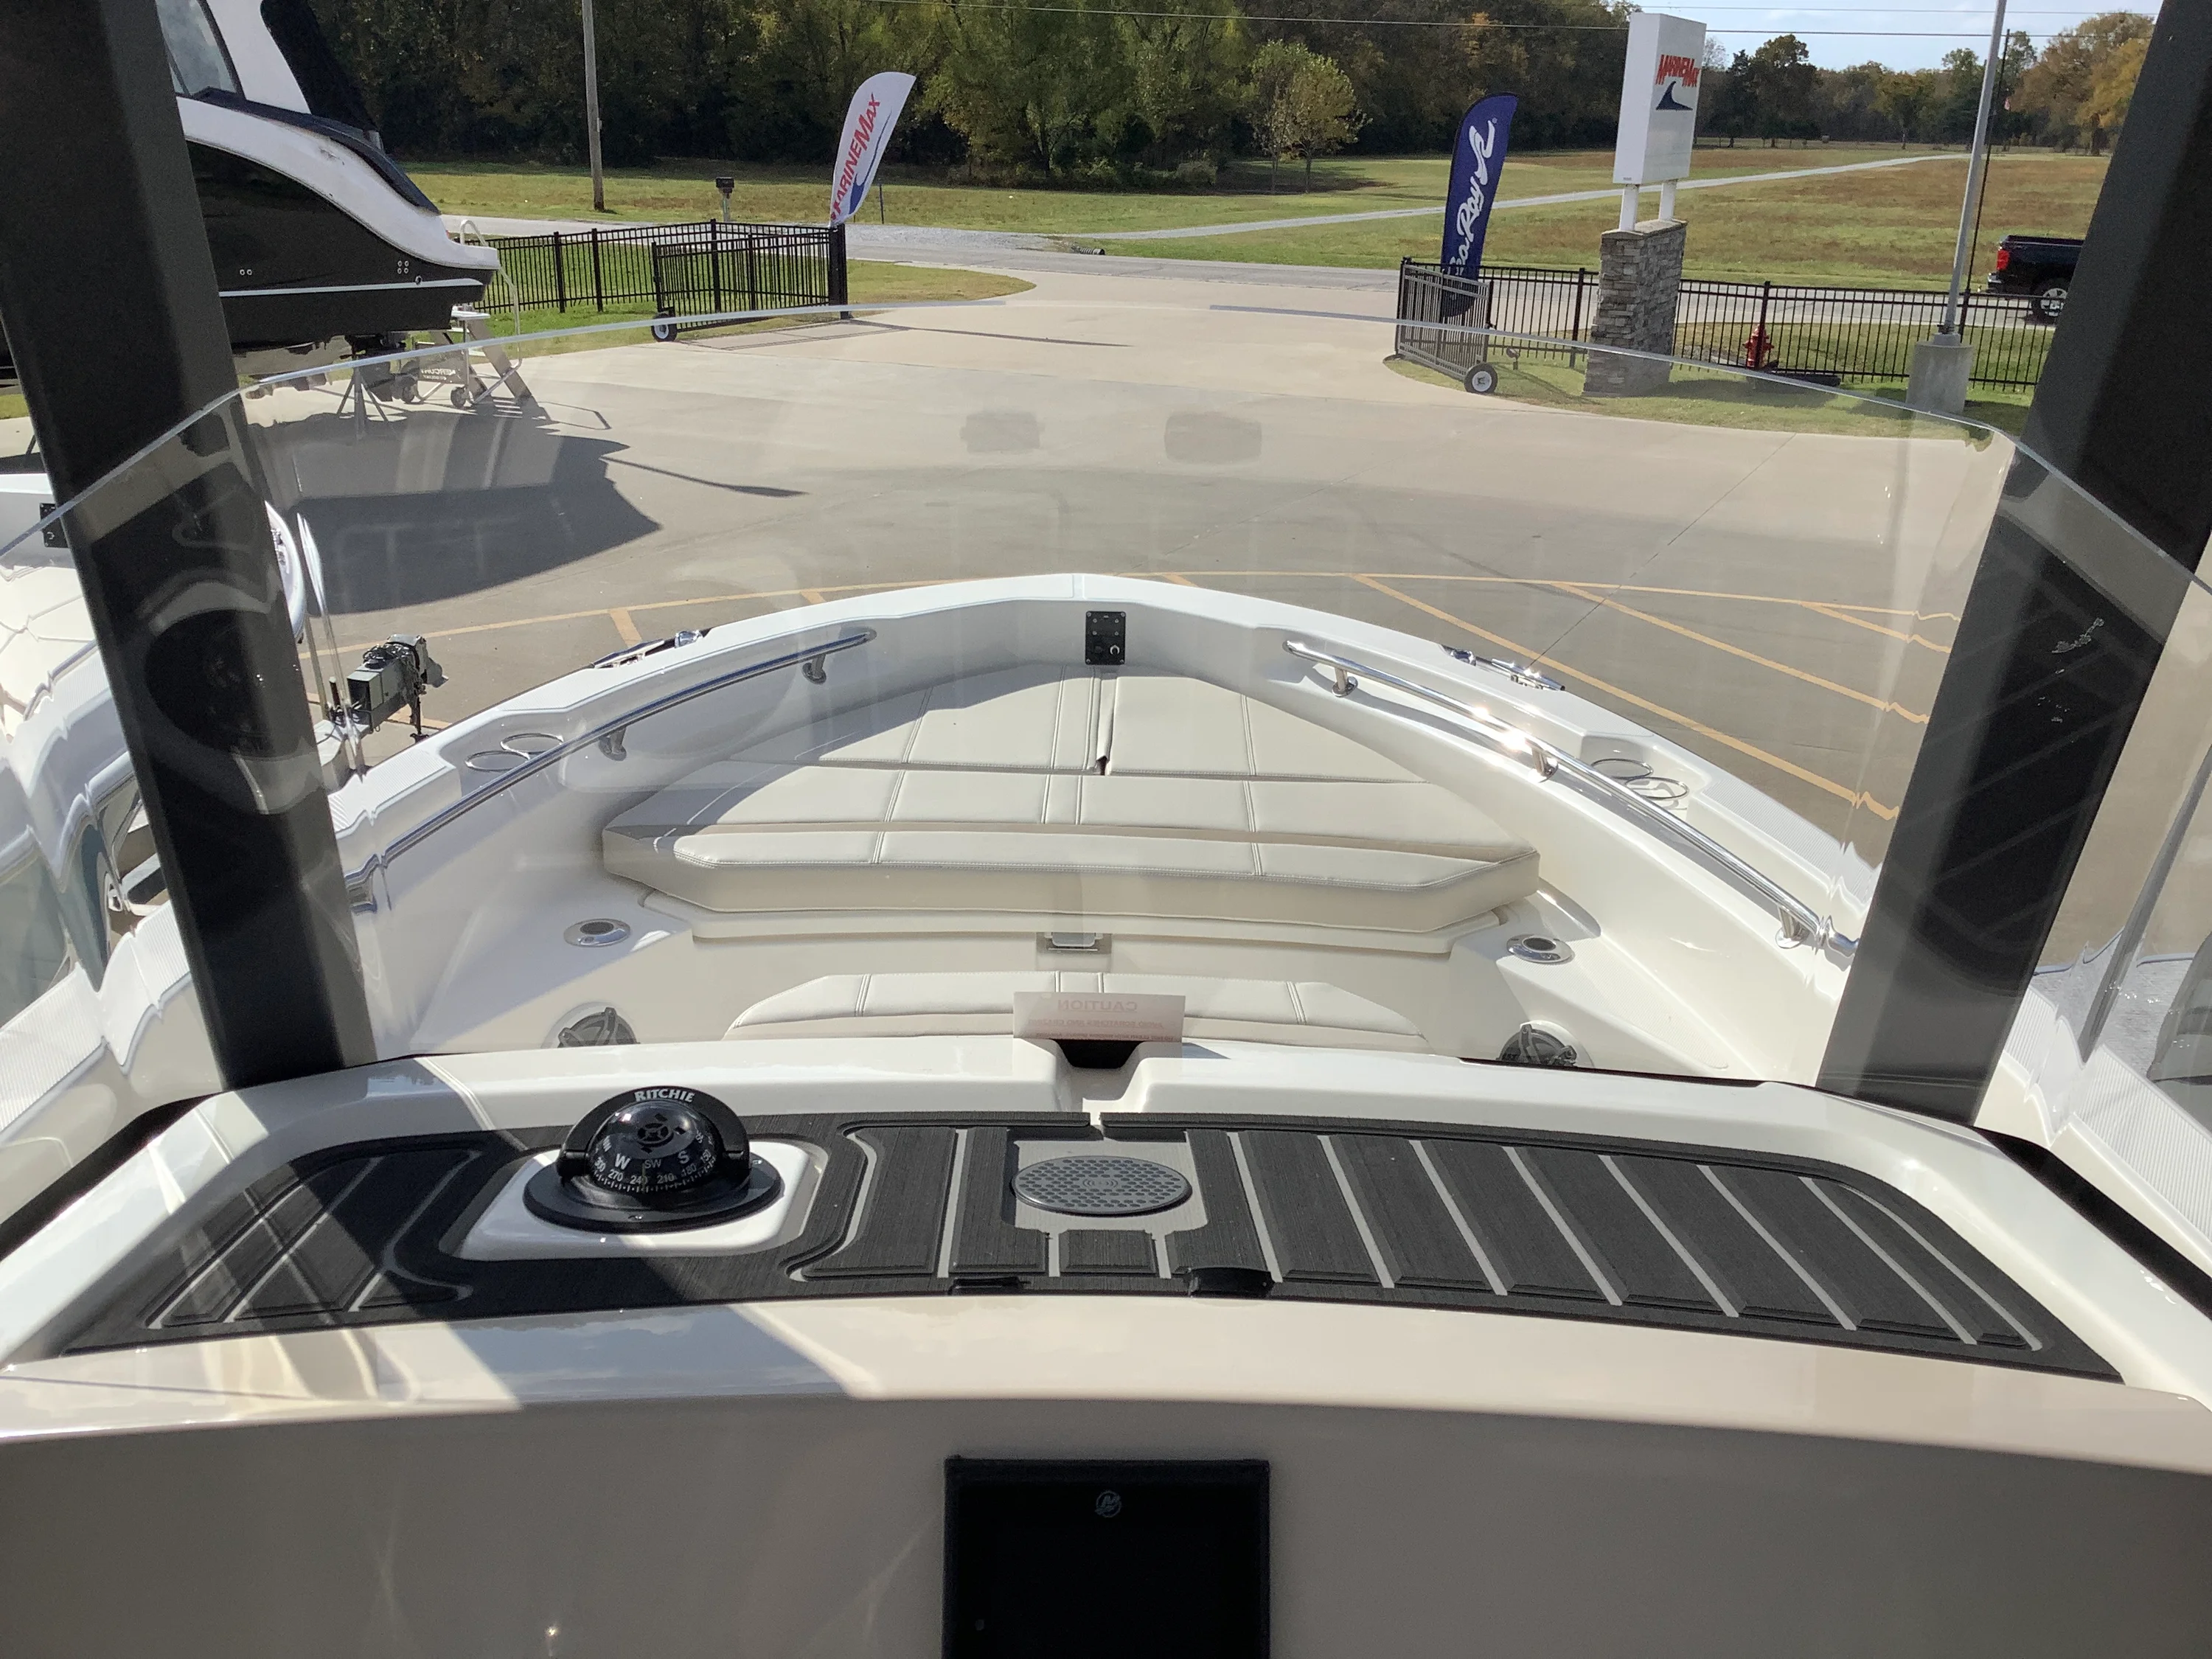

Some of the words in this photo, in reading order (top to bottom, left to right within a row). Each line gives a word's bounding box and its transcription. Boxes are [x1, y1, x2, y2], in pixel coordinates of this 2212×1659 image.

[1457, 176, 1484, 243] Ray
[634, 1089, 695, 1103] RITCHIE
[614, 1153, 630, 1170] W
[644, 1159, 661, 1169] SW
[678, 1150, 689, 1164] S
[608, 1169, 623, 1181] 270
[630, 1175, 647, 1184] 240
[657, 1173, 675, 1184] 210
[681, 1163, 697, 1177] 180
